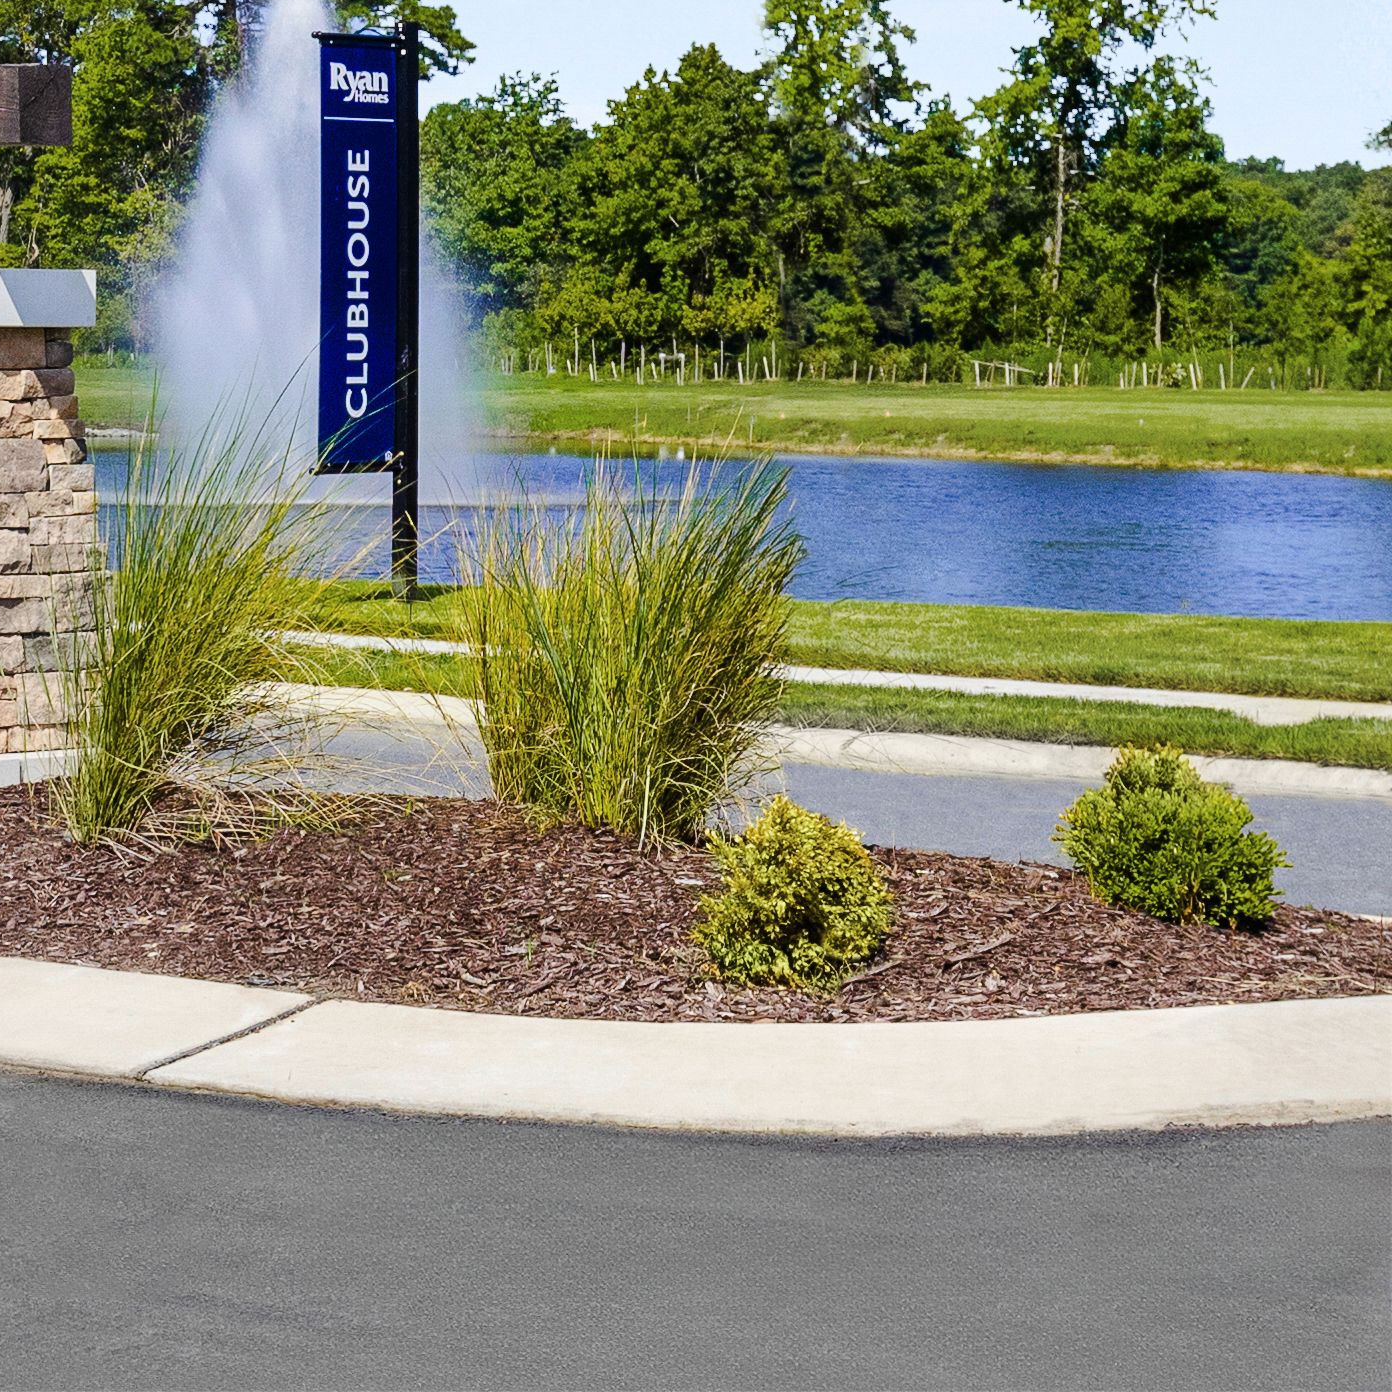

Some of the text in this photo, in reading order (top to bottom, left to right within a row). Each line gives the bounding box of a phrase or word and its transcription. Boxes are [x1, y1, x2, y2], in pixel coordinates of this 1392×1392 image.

[329, 61, 389, 102] Ryan
[354, 90, 390, 104] Homes
[345, 149, 370, 419] CLUBHOUSE
